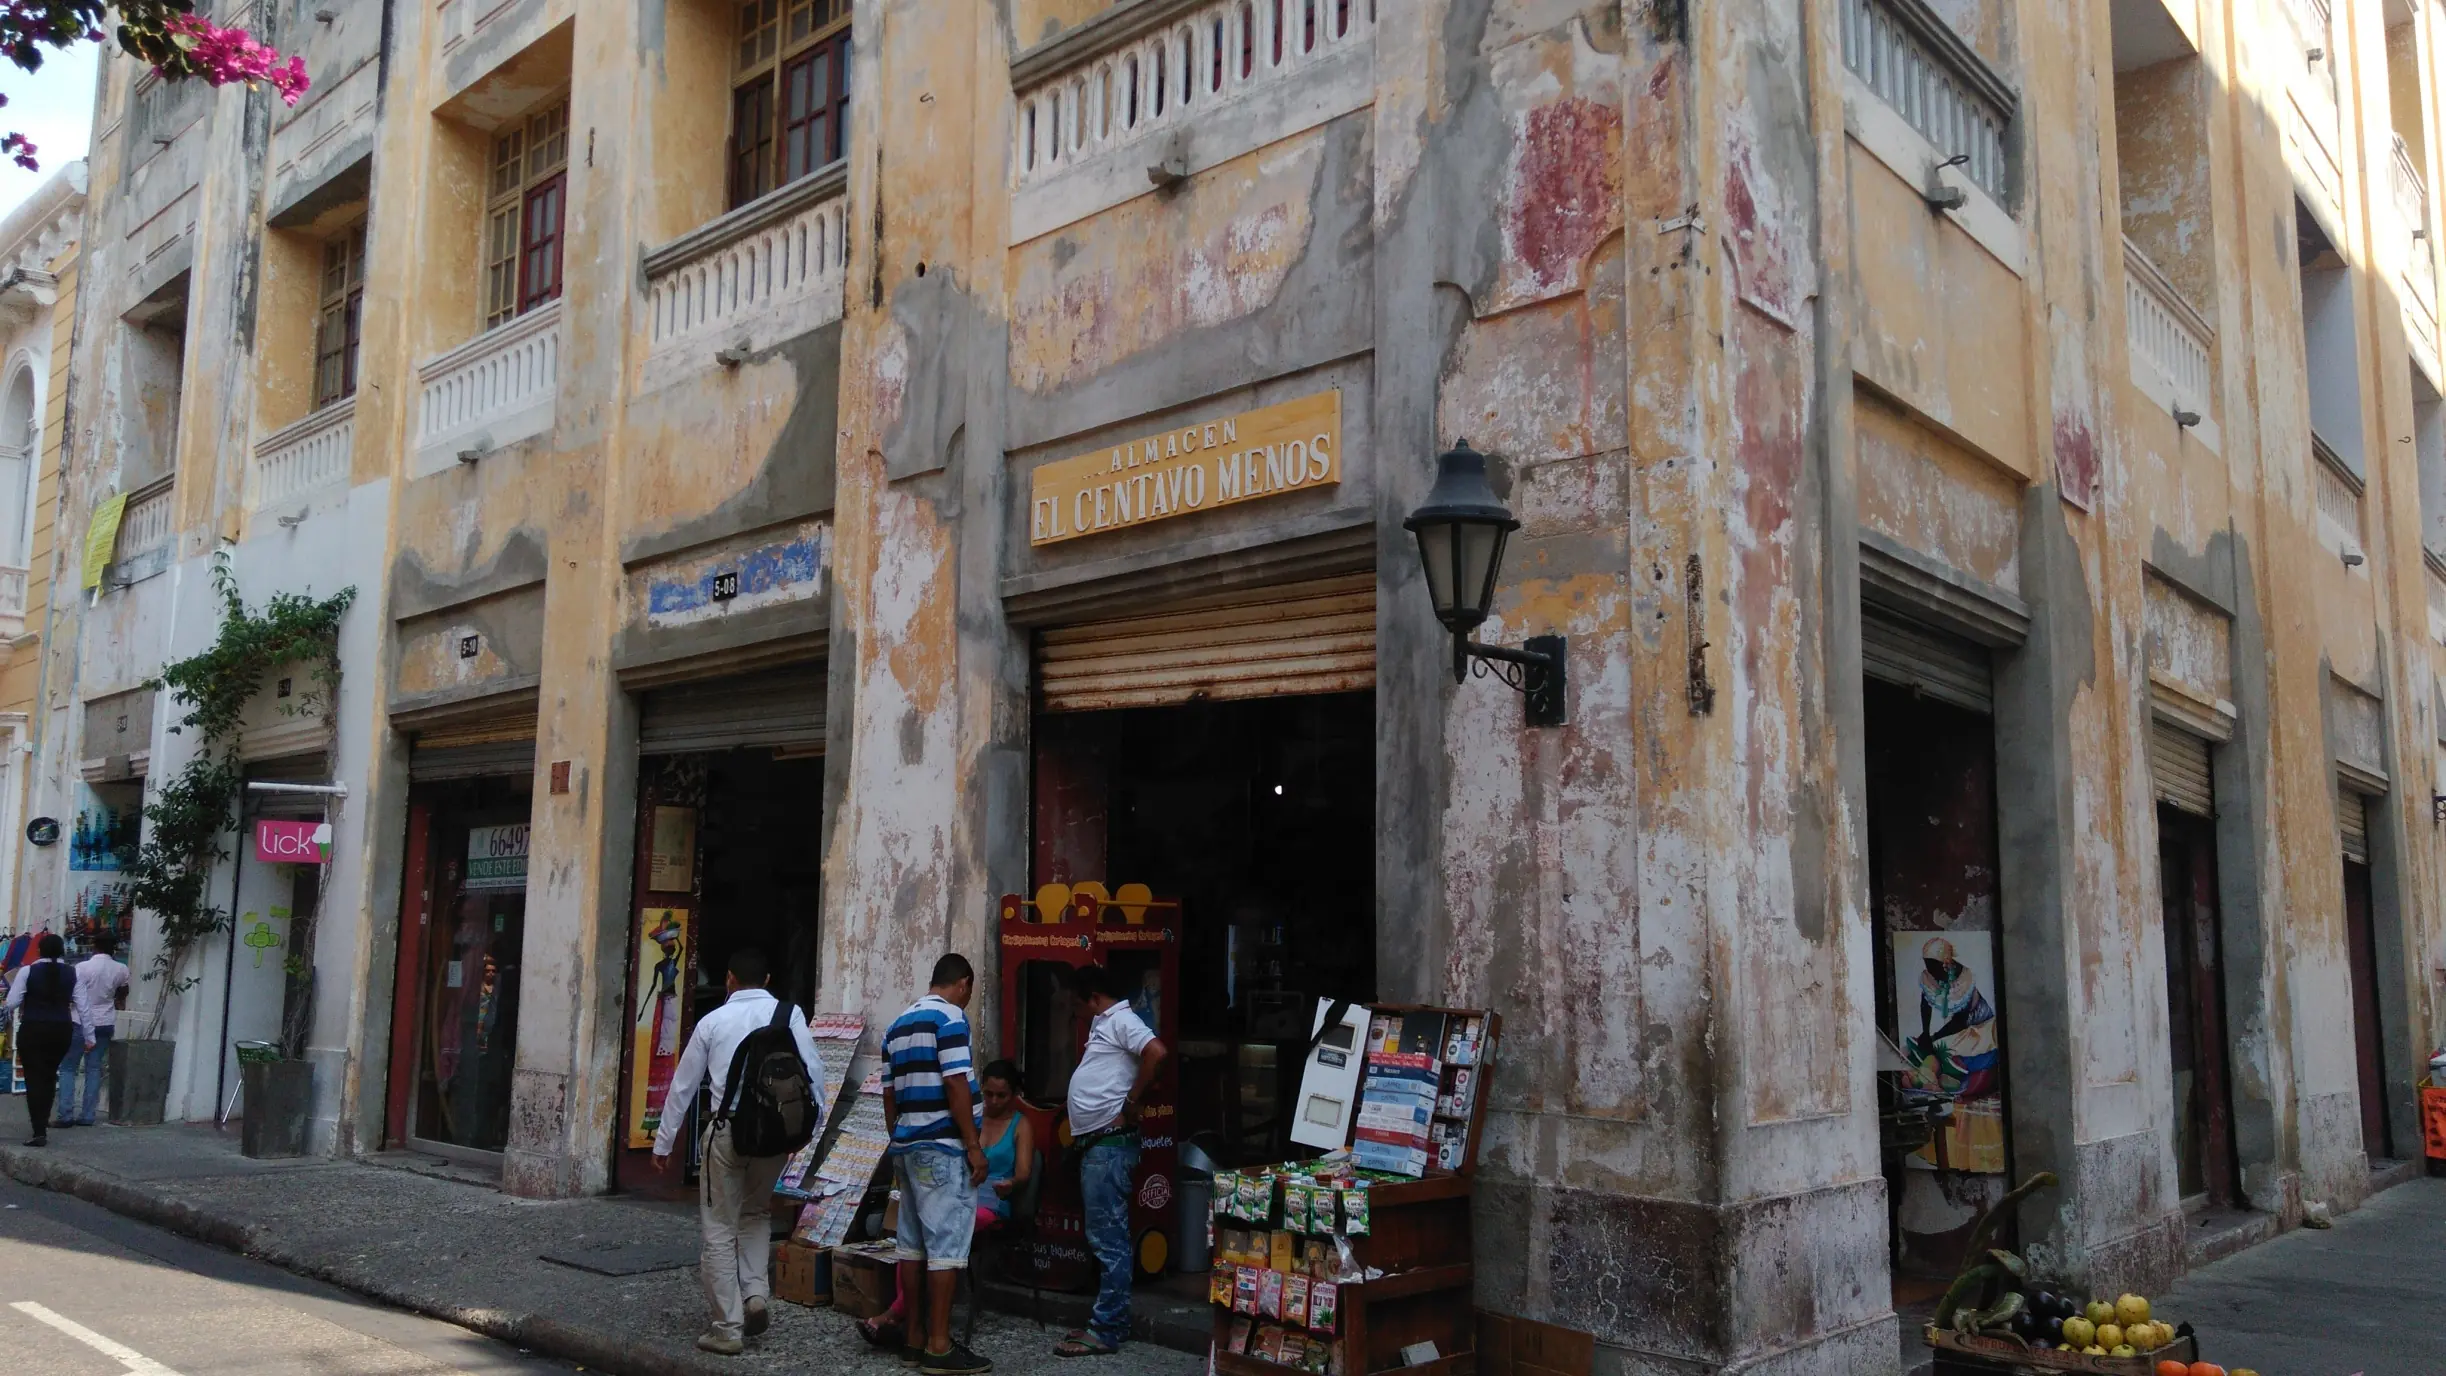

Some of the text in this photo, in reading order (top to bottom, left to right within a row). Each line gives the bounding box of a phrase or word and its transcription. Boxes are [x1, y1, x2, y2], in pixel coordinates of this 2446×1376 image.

[1110, 418, 1237, 473] ALMACEN
[1033, 432, 1331, 541] EL CENTAVO MENOS
[714, 576, 735, 597] 5-08
